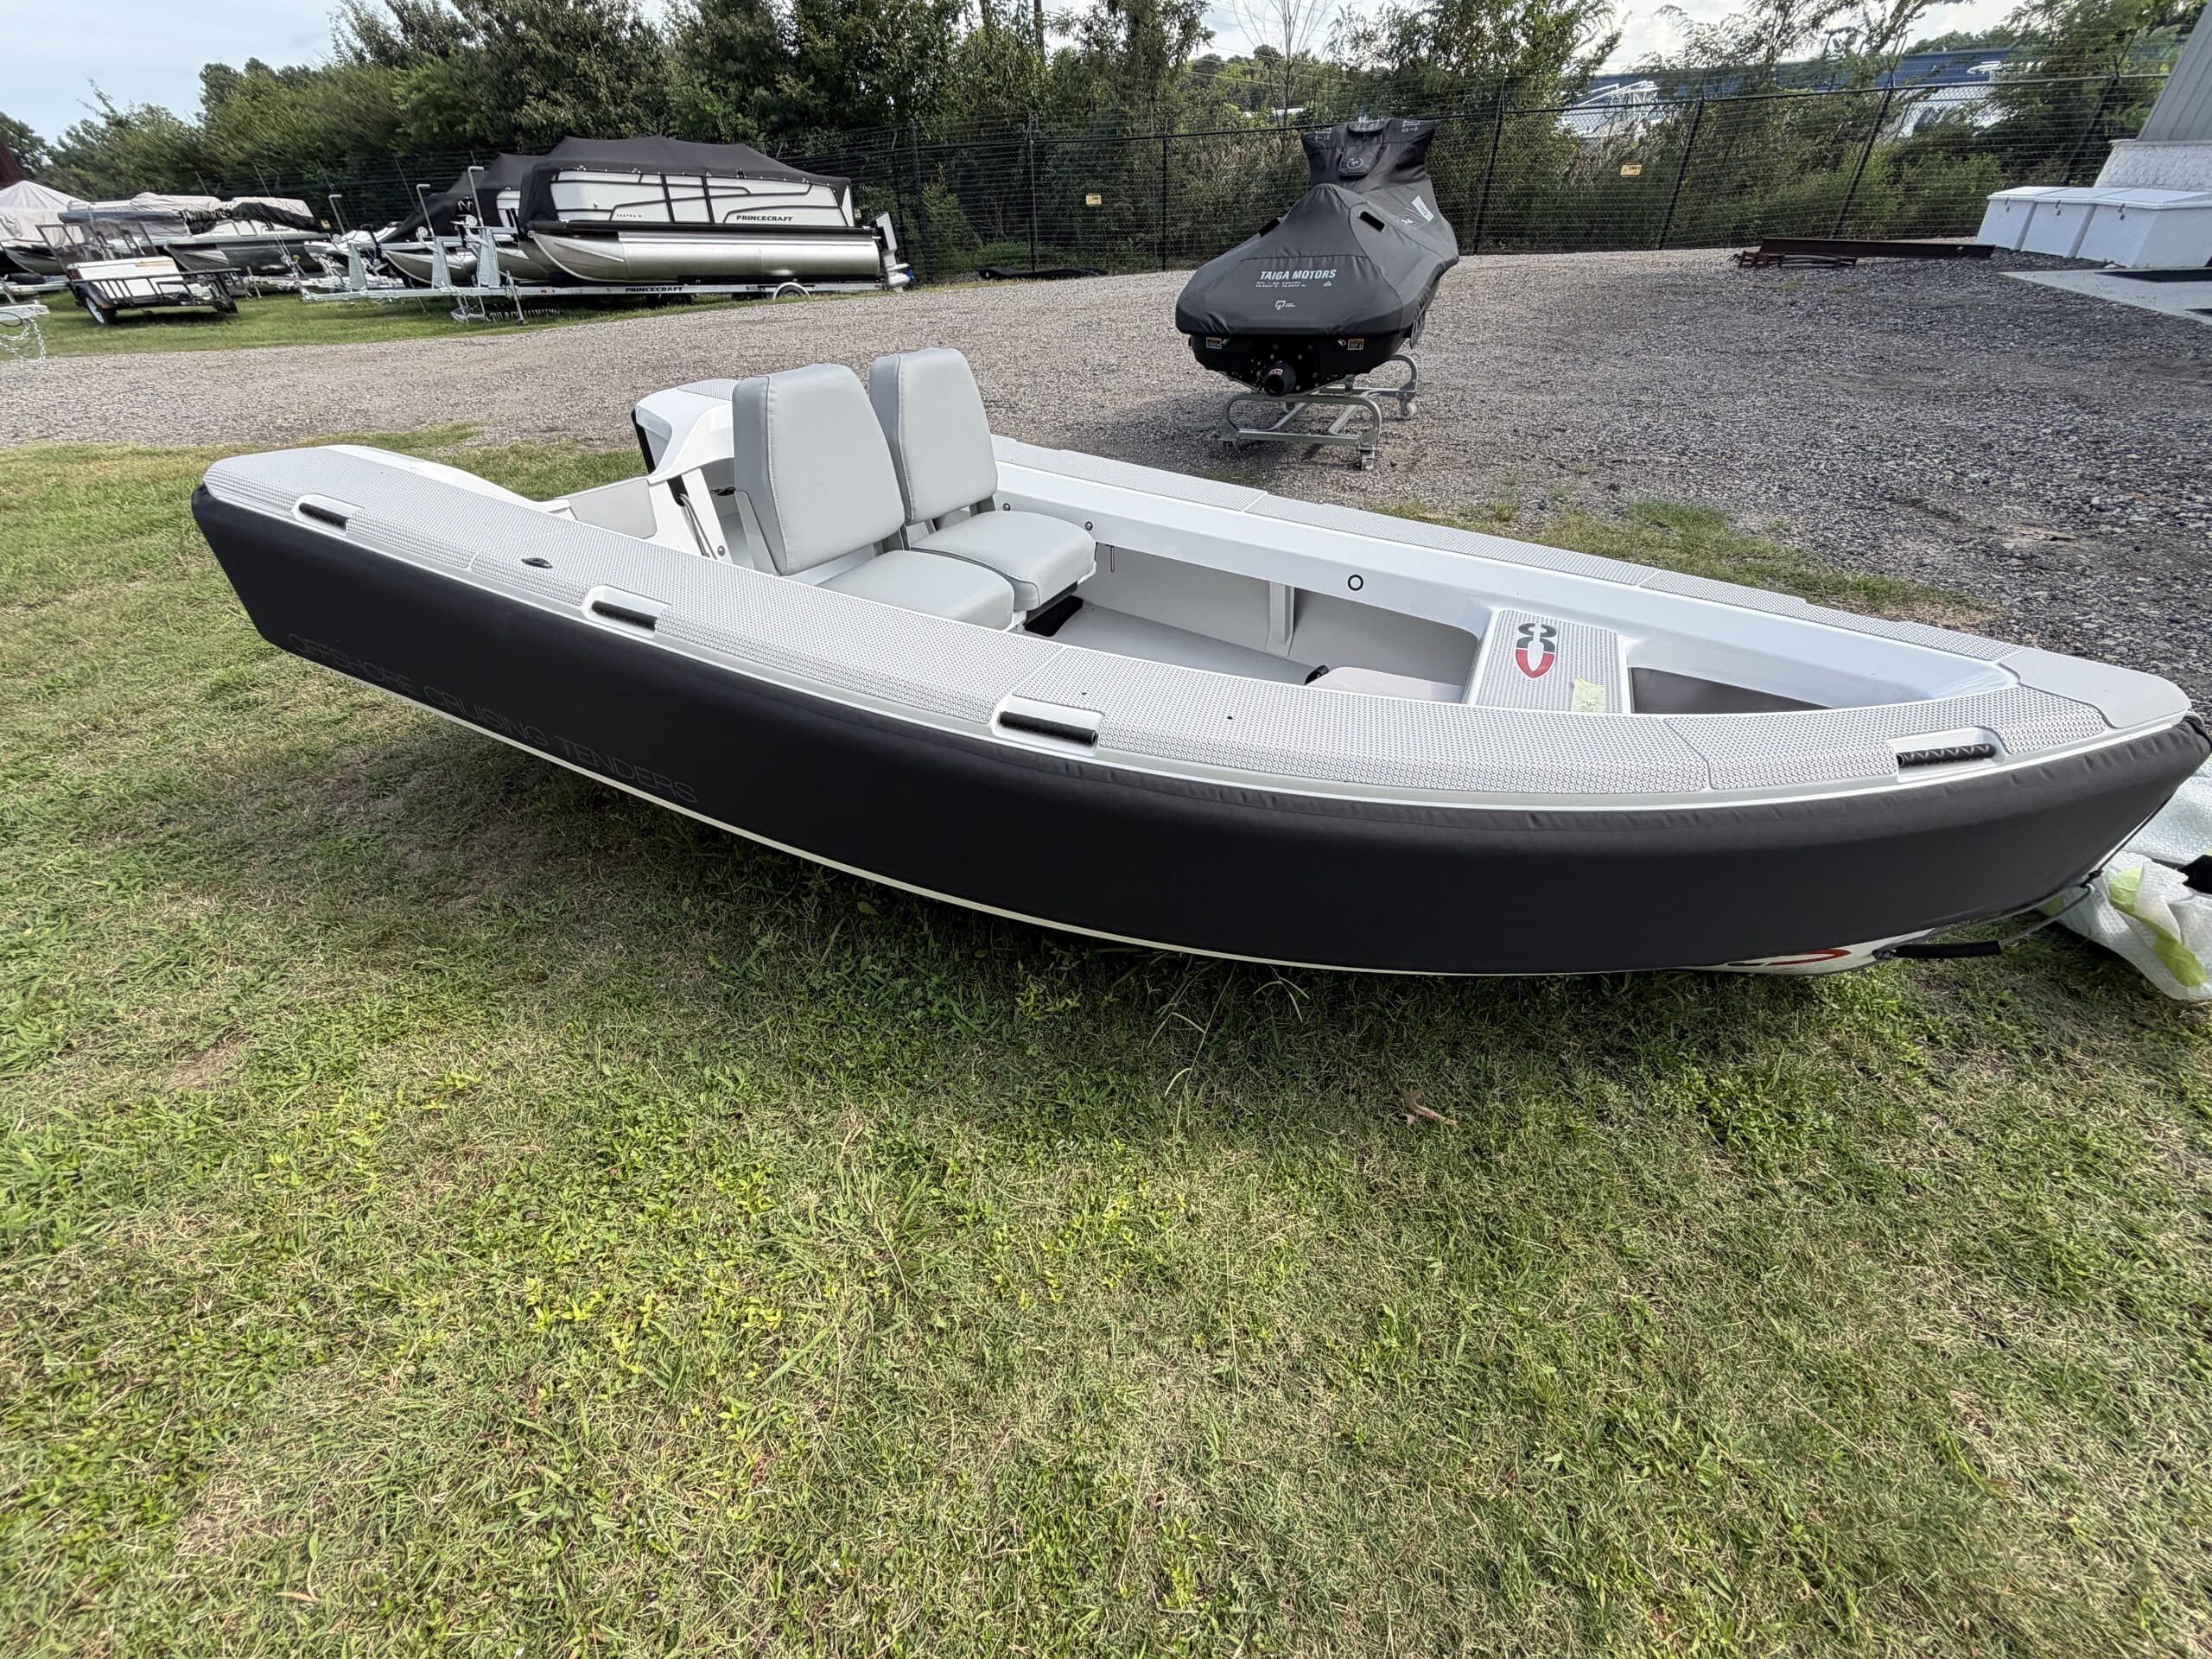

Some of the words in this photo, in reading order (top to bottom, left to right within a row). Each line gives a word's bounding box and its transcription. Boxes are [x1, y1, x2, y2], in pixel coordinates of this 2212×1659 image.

[1260, 270, 1290, 280] TAIGA
[1292, 269, 1337, 279] MOTORS
[288, 633, 420, 697] OFFSHORE
[423, 685, 548, 747] CRUISING
[554, 734, 697, 804] TENDERS
